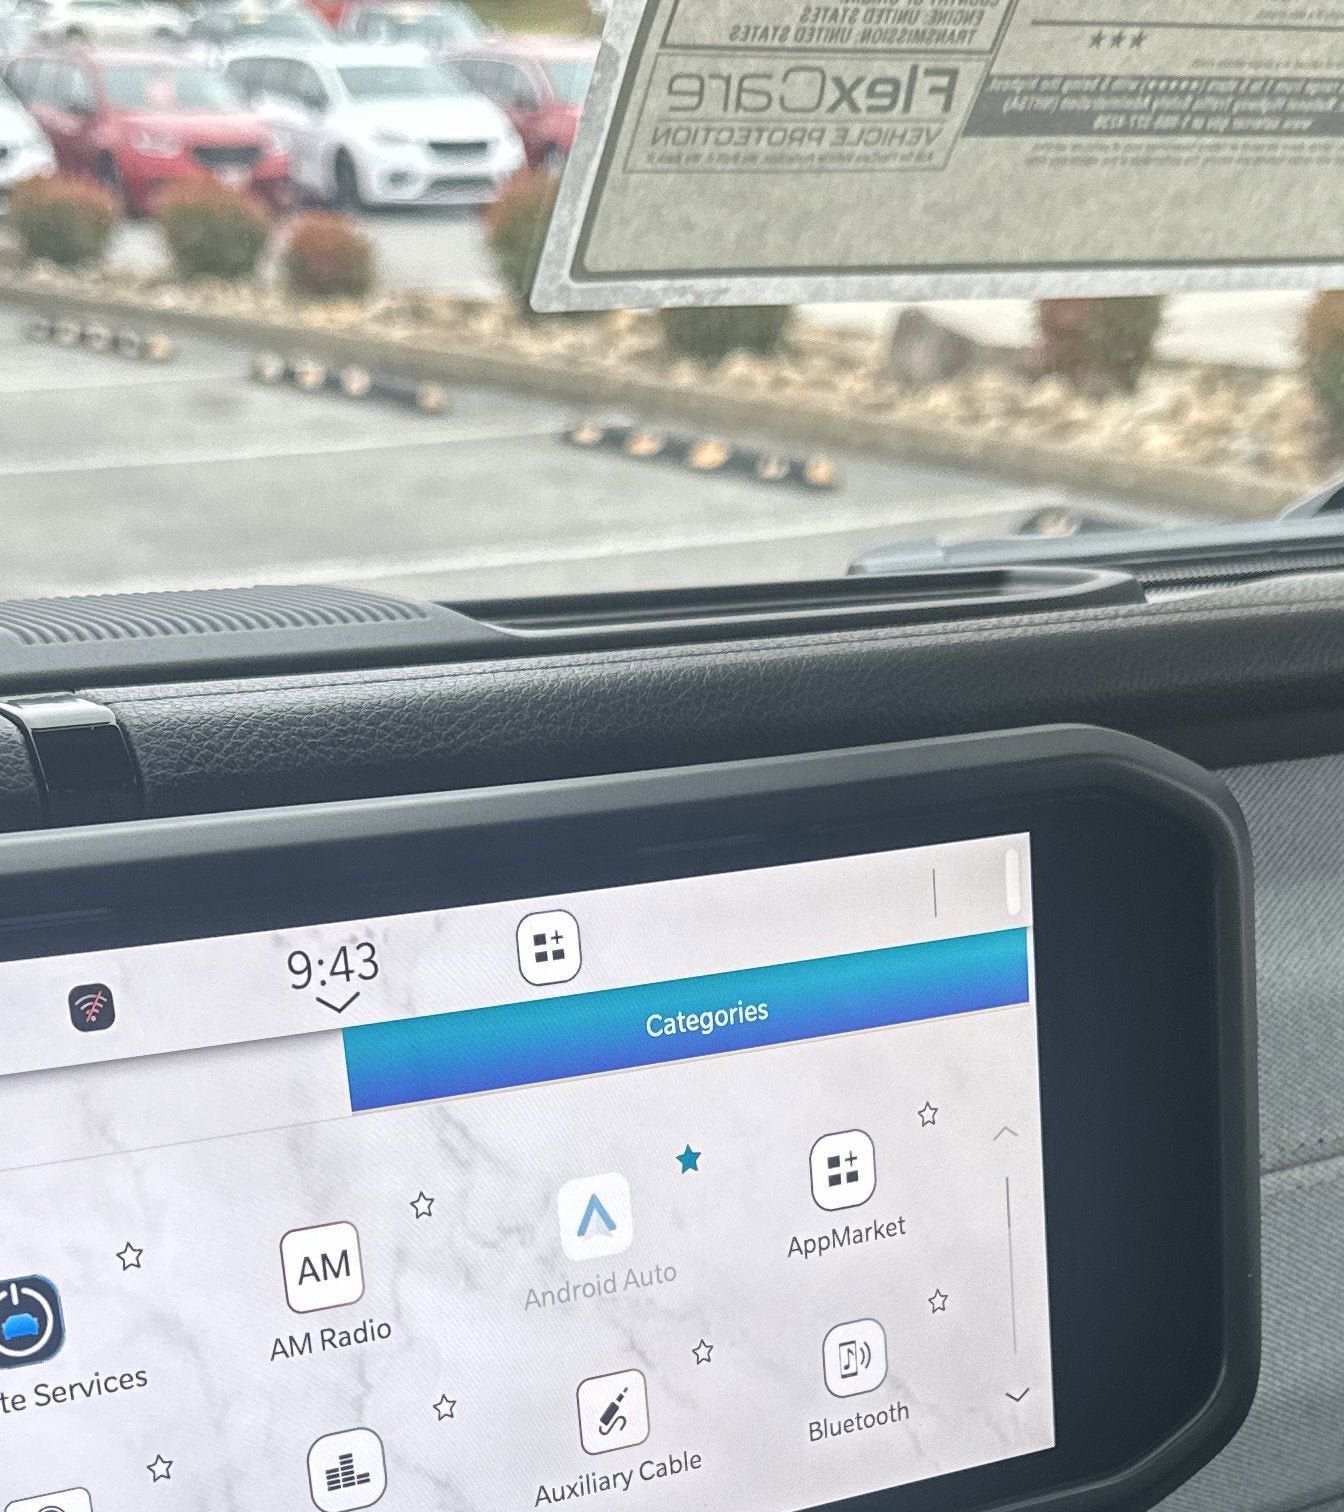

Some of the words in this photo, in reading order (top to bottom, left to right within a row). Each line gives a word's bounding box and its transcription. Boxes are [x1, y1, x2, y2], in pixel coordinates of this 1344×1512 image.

[288, 942, 378, 989] 9:43
[646, 1000, 769, 1038] Categories
[787, 1215, 906, 1259] AppMarket
[298, 1250, 351, 1286] AM
[524, 1271, 617, 1311] Android
[623, 1262, 677, 1291] Auto
[270, 1332, 314, 1362] AM
[320, 1318, 392, 1352] Radio
[34, 1366, 148, 1407] Services
[809, 1402, 910, 1442] Bluetooth
[534, 1469, 634, 1508] Auxiliary
[639, 1450, 702, 1481] Cable
